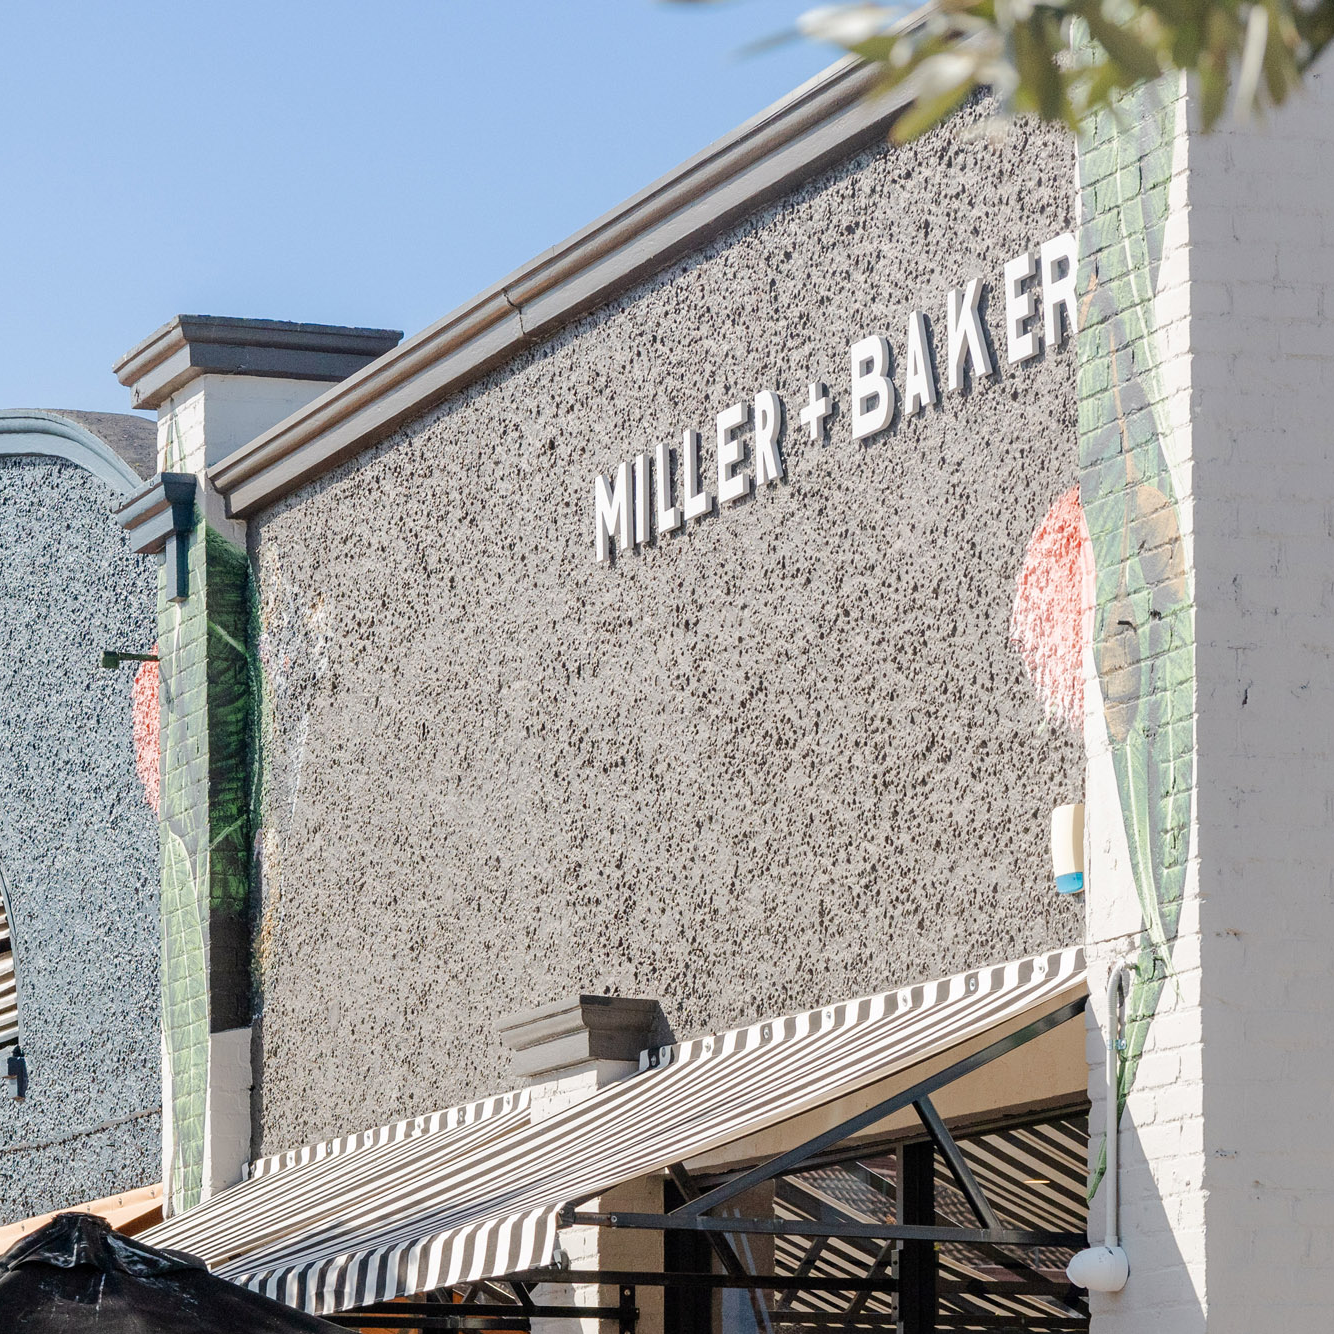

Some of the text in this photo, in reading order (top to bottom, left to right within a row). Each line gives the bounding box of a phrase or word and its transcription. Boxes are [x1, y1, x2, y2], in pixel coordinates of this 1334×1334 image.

[594, 232, 1080, 563] MILLER + BAKER
